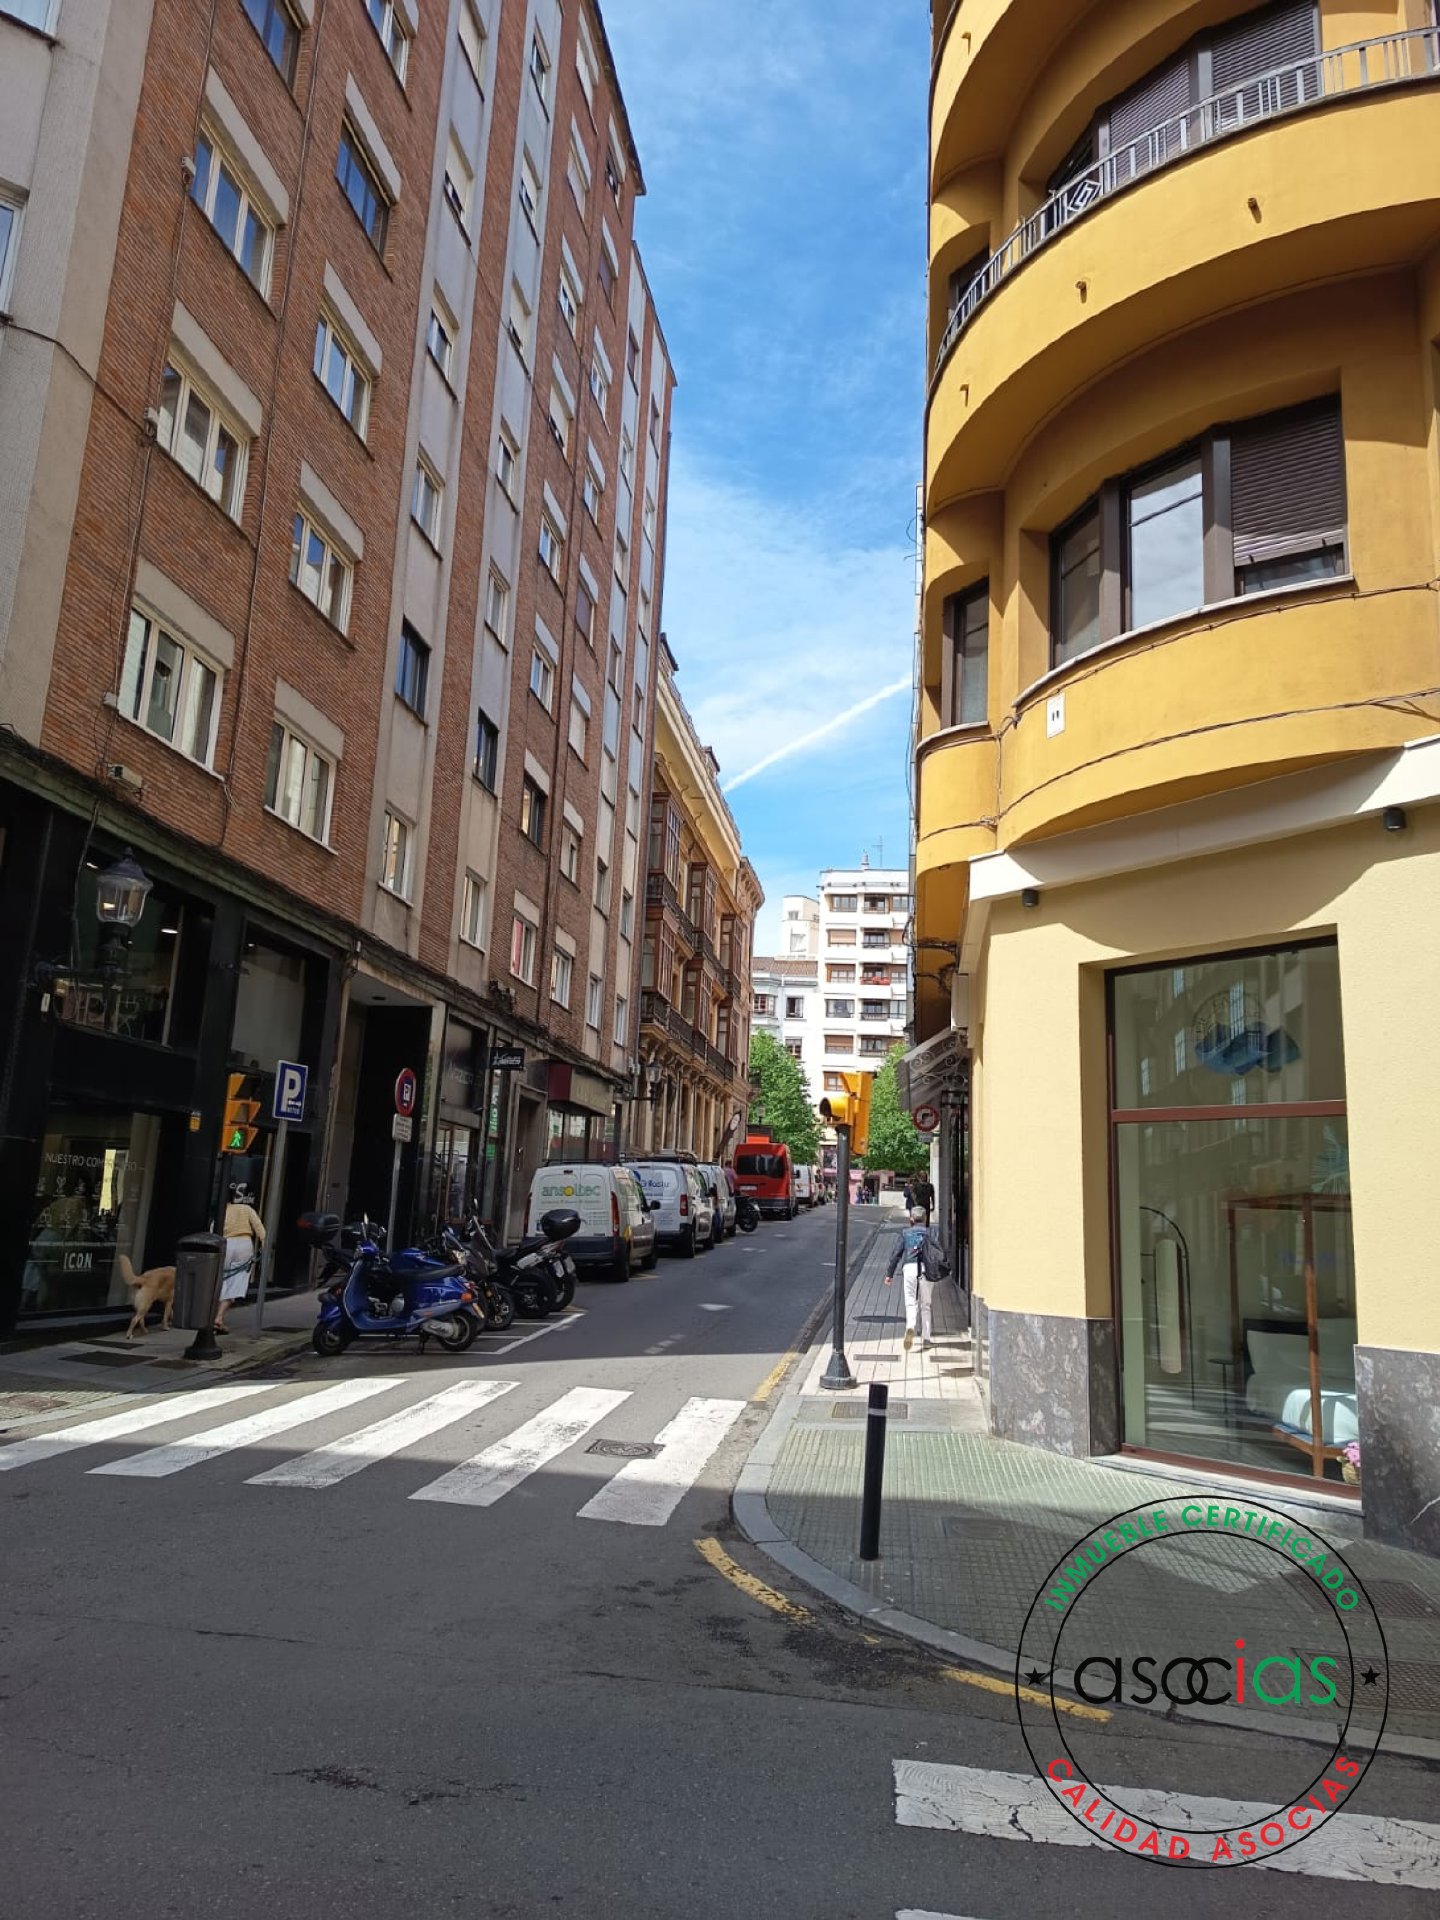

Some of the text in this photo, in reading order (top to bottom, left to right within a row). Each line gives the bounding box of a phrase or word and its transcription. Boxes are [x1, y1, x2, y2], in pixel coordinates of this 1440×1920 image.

[281, 1068, 301, 1112] P
[45, 1153, 84, 1167] NUESTRO
[63, 1252, 93, 1269] ICON
